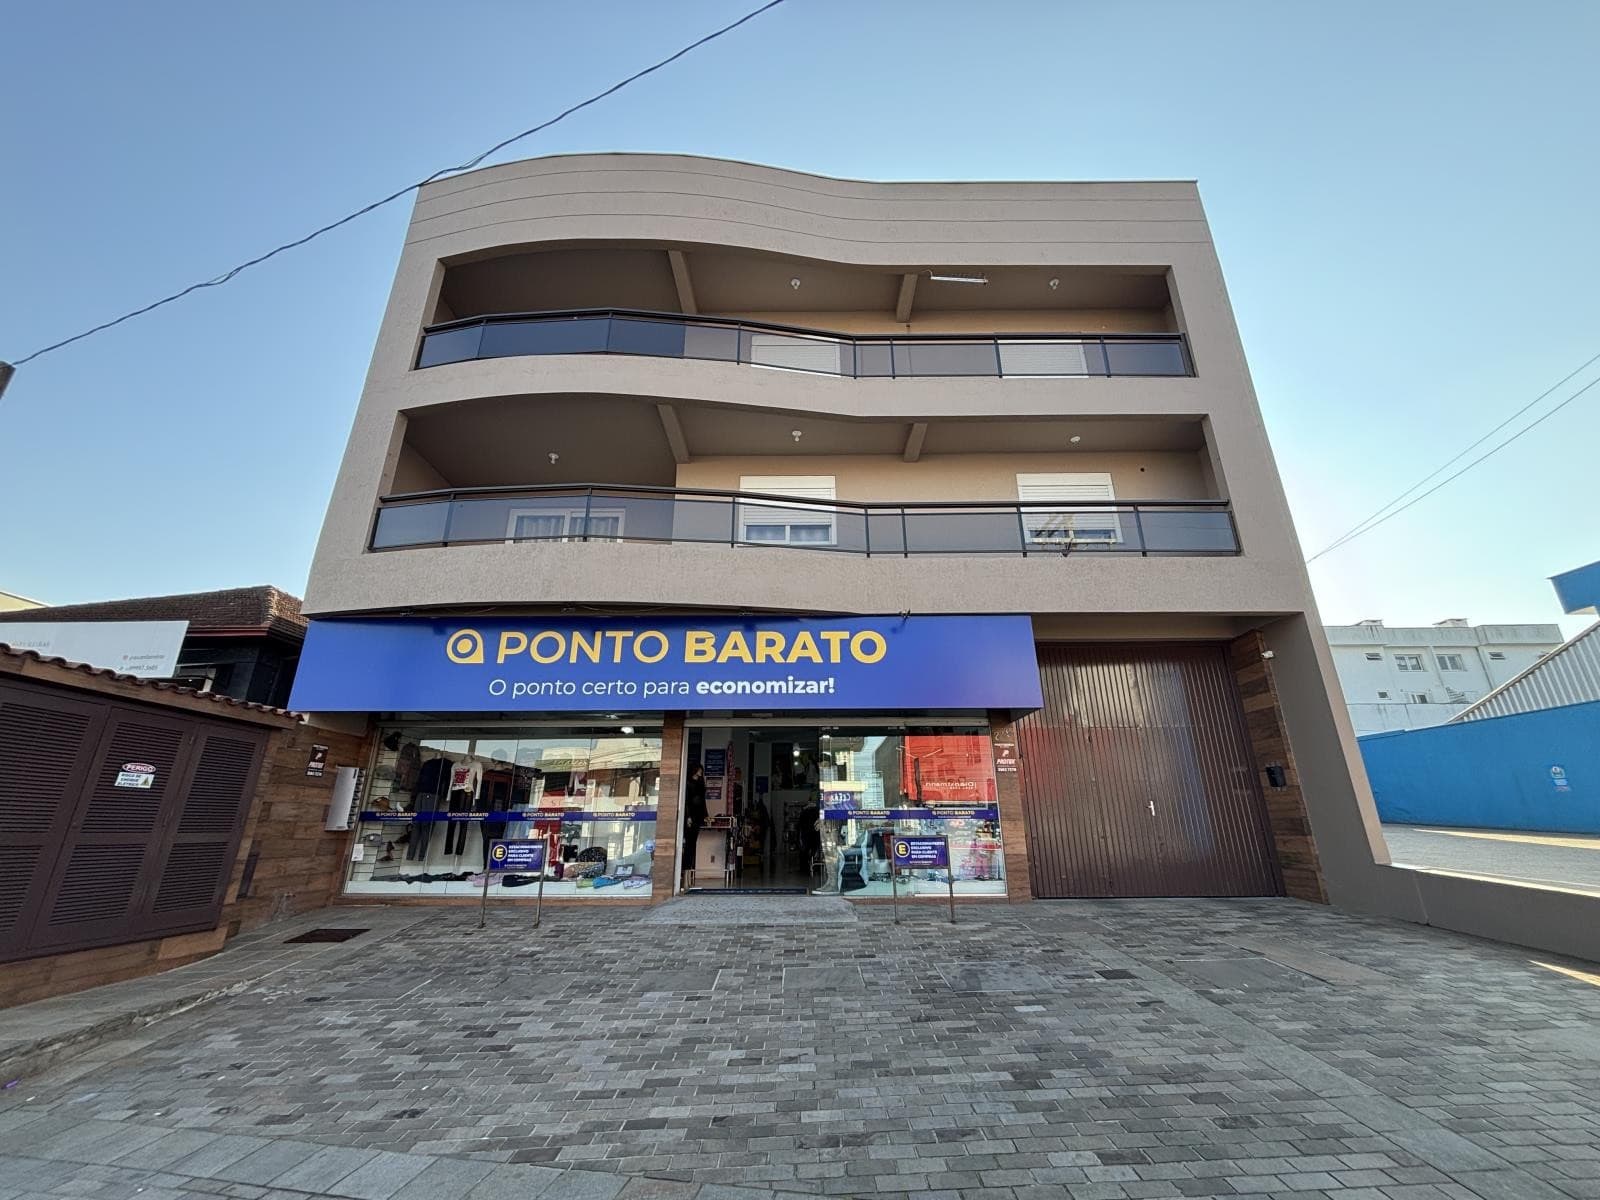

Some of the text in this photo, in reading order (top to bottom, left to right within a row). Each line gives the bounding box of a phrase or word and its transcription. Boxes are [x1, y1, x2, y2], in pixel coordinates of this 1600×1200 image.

[497, 630, 887, 664] PONTO BARATO
[489, 675, 835, 699] O ponto certo para economizar!
[496, 848, 503, 858] E
[898, 845, 906, 854] E
